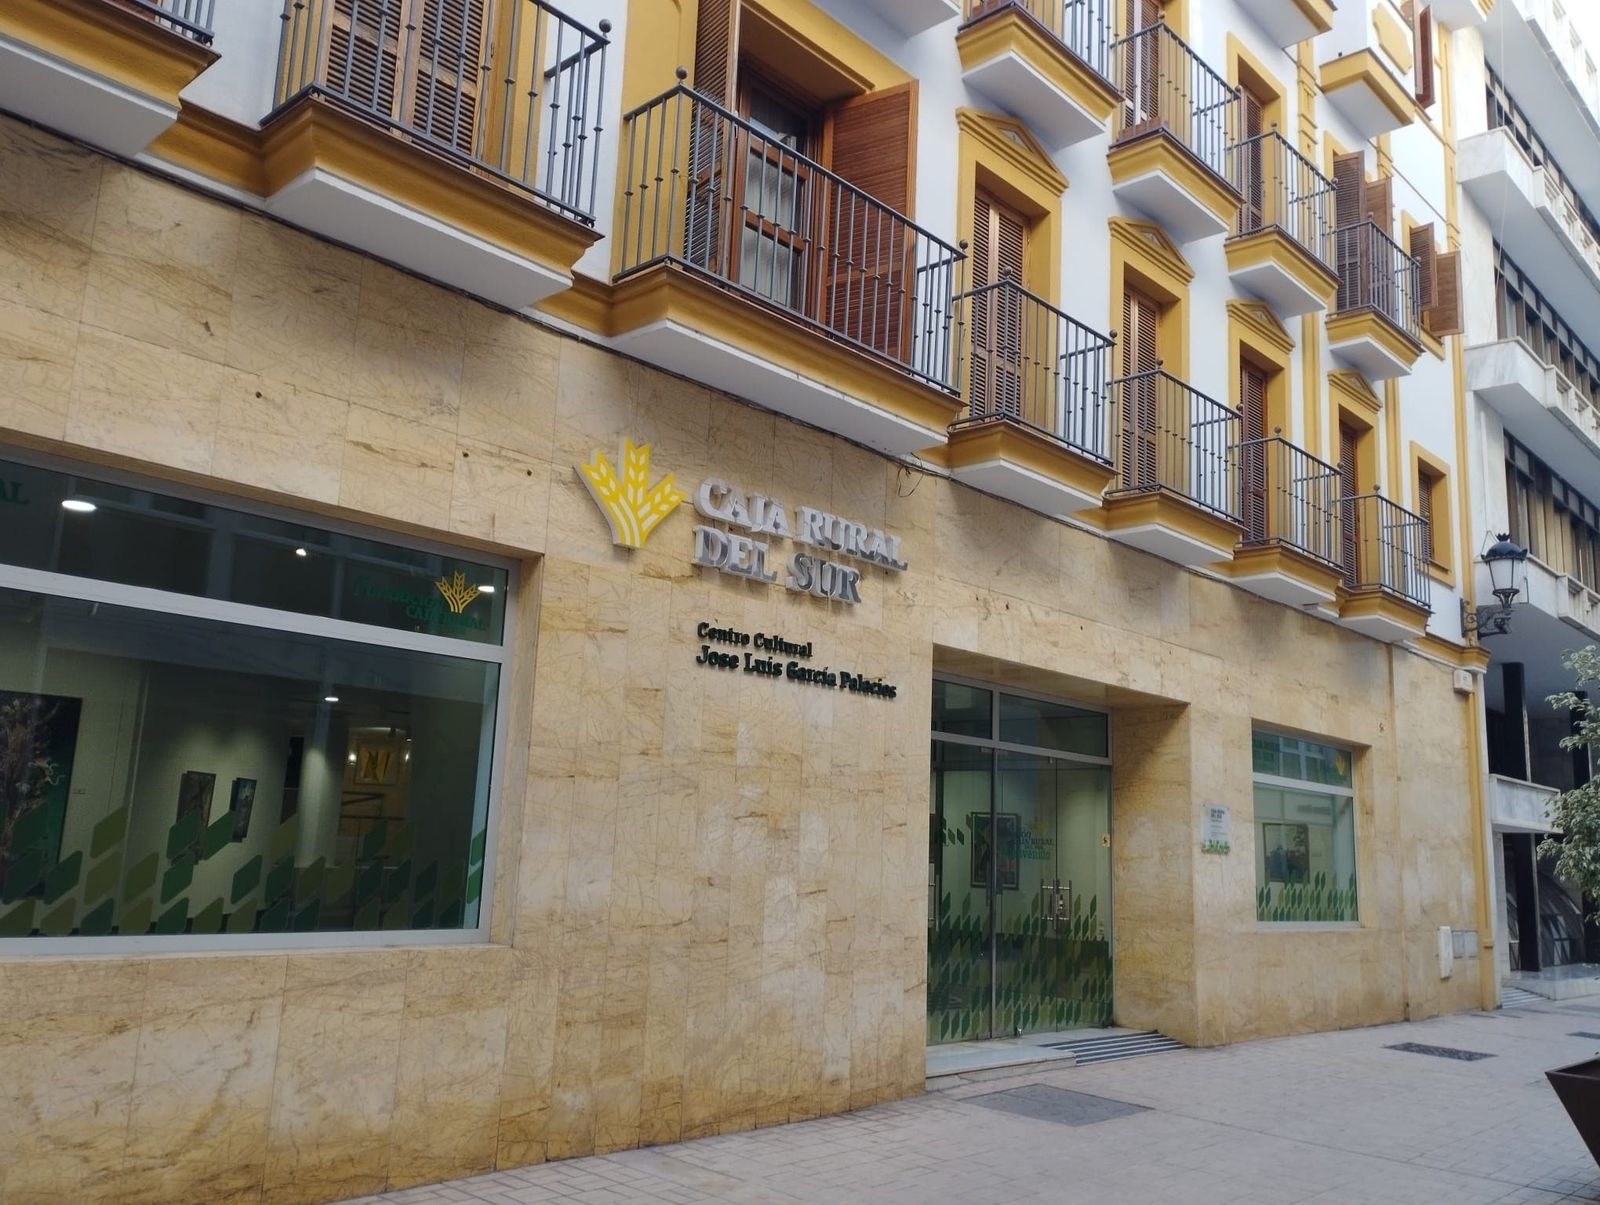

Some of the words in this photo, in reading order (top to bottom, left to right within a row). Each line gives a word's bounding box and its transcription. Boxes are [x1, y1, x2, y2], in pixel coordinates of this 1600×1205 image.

[693, 477, 793, 539] CAJA
[793, 506, 908, 571] RURAL
[692, 524, 778, 583] DEL
[785, 552, 862, 604] SUR
[696, 645, 740, 669] Jose
[839, 671, 897, 699] Palacios
[697, 622, 750, 647] Centro
[753, 632, 813, 658] Cultural
